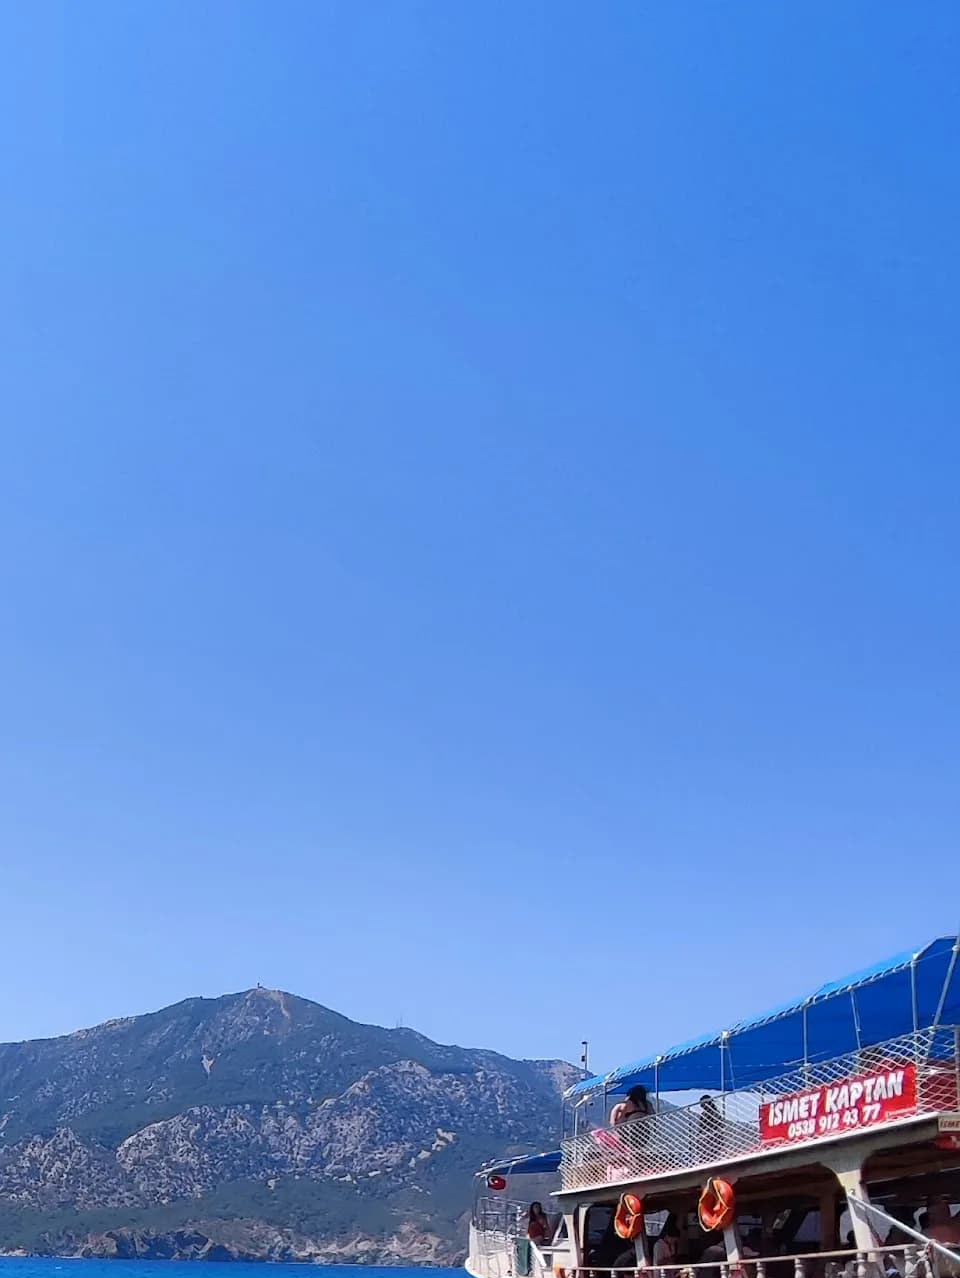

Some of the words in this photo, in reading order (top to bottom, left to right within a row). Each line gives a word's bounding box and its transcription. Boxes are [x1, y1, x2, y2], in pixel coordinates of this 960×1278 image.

[825, 1070, 904, 1112] KAPTAN
[787, 1118, 816, 1138] 0538
[819, 1113, 840, 1133] 912
[843, 1108, 859, 1126] 43
[862, 1103, 882, 1122] 77
